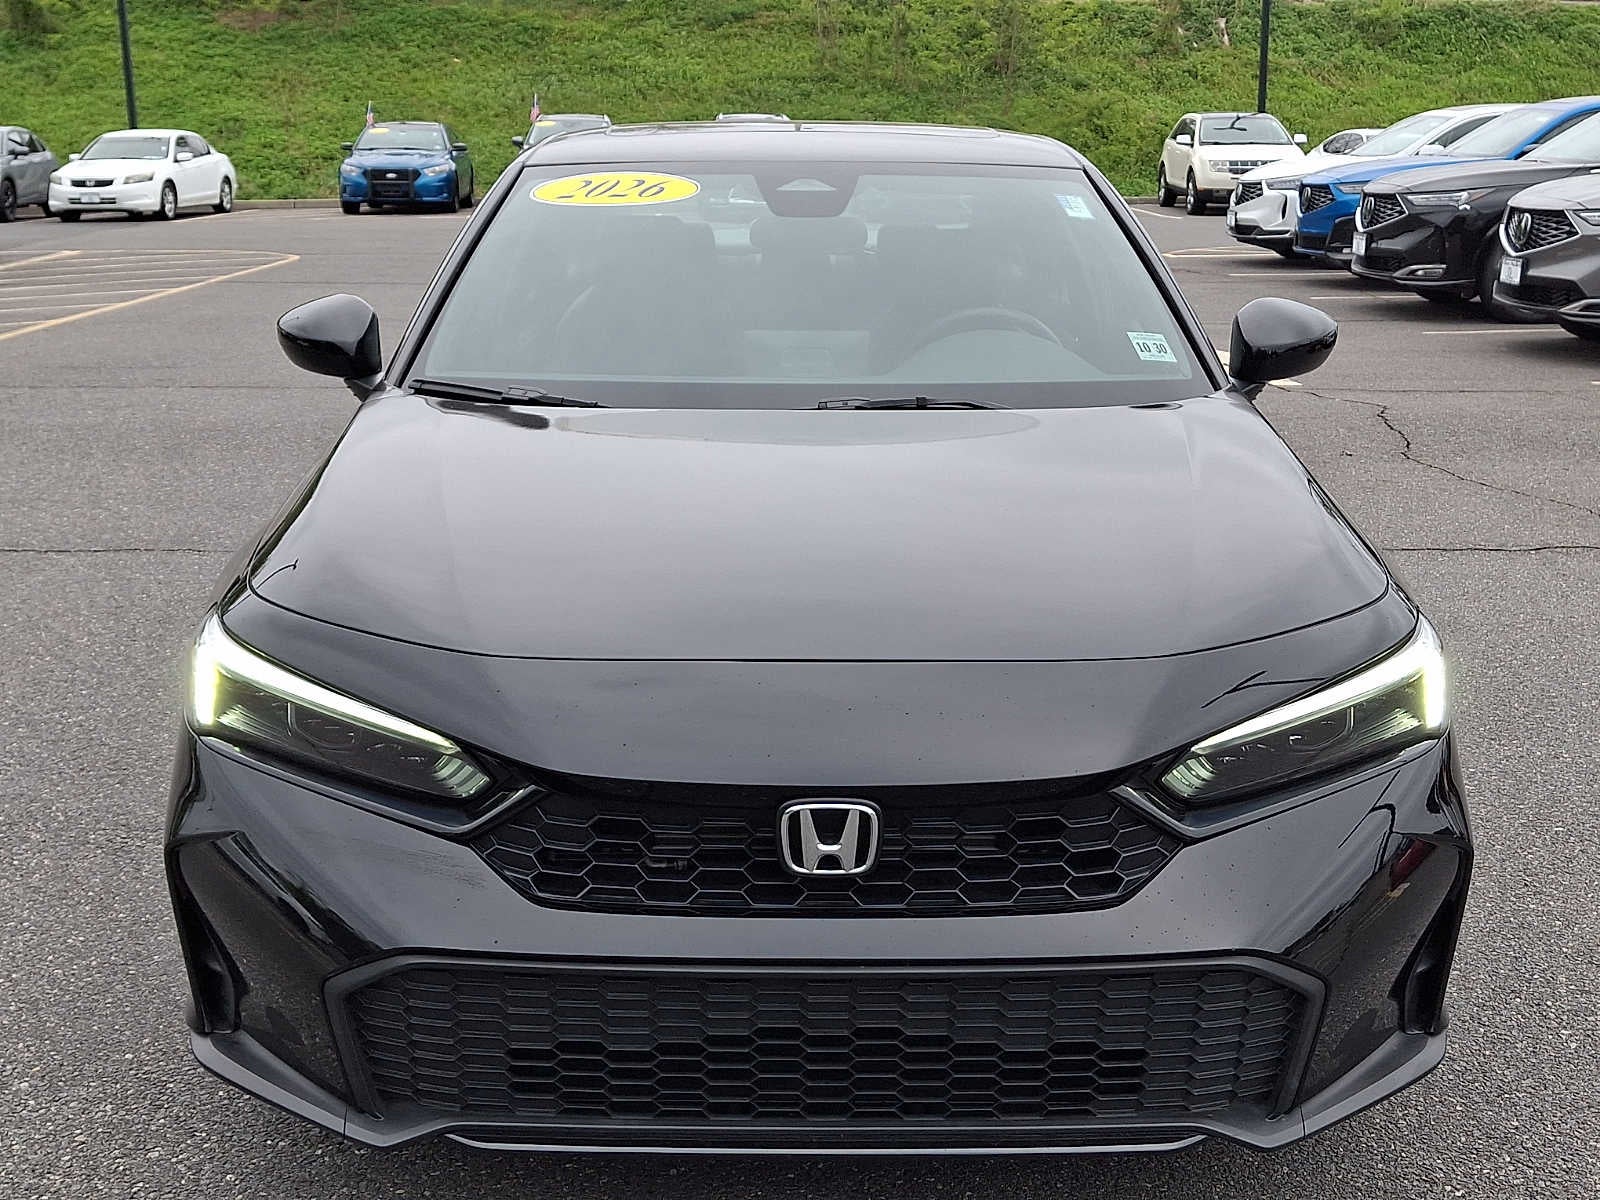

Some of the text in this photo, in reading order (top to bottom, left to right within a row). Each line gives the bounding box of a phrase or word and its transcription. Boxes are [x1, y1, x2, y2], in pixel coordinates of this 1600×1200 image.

[556, 179, 671, 199] 2026
[1135, 342, 1168, 354] 10 30
